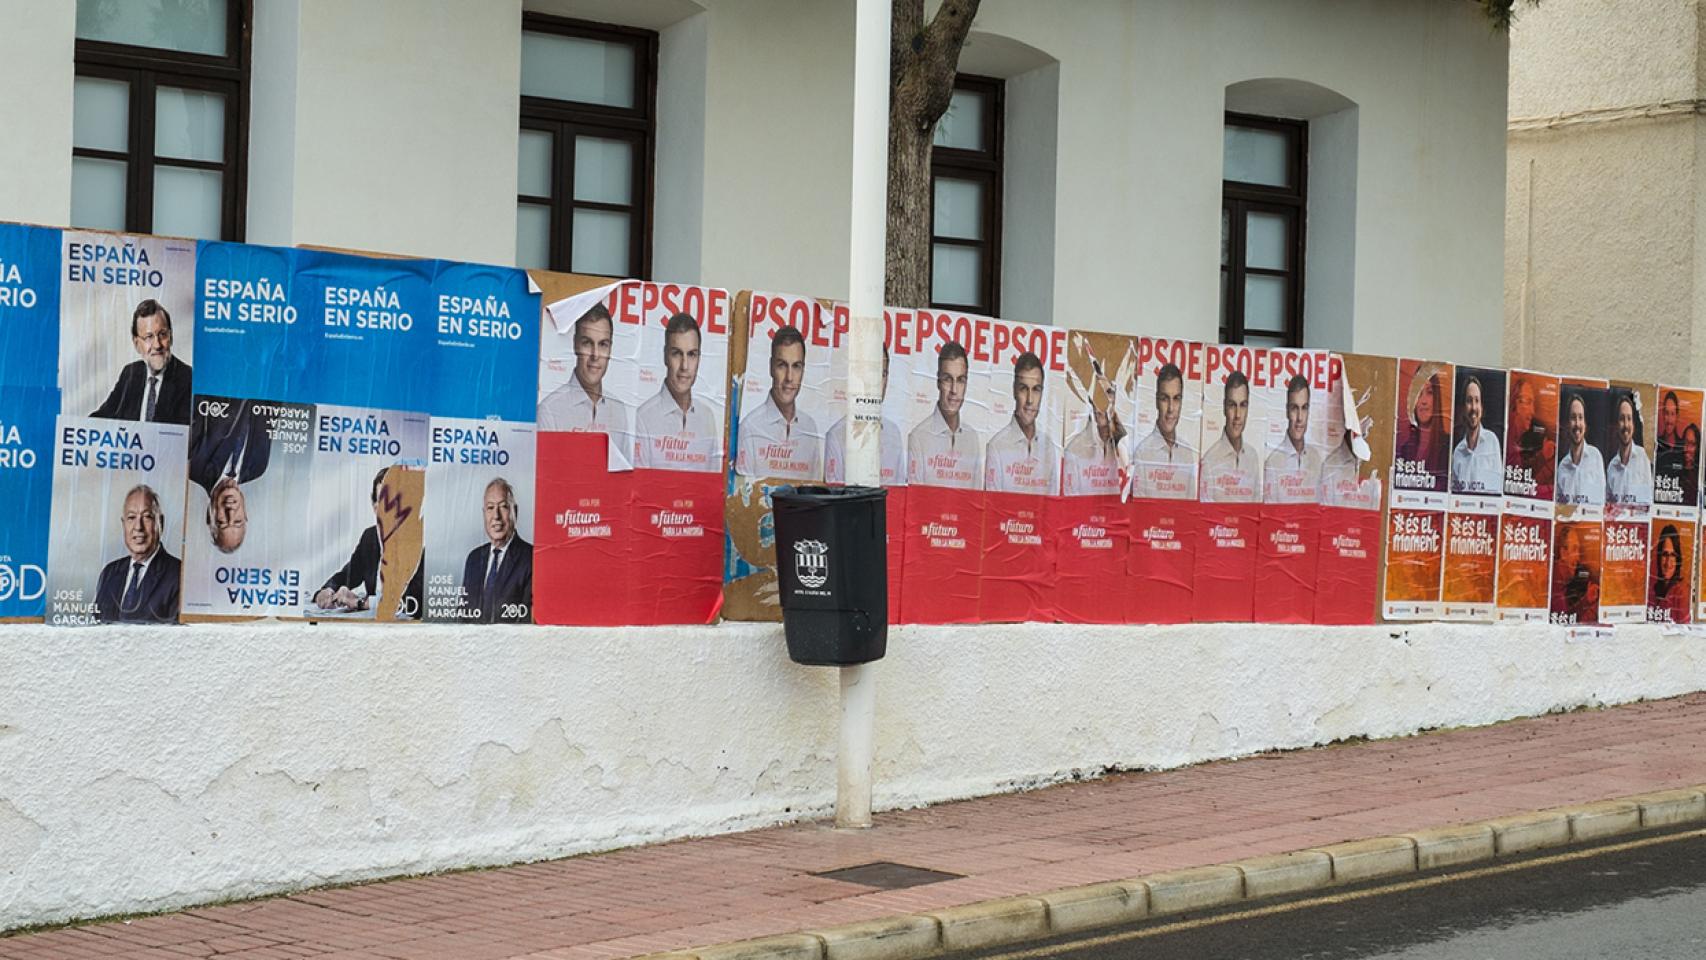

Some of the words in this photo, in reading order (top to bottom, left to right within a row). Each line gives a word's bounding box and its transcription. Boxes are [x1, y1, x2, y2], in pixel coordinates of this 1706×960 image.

[69, 243, 150, 266] ESPAÑA
[69, 265, 95, 283] EN
[103, 267, 164, 288] SERIO
[0, 288, 37, 308] RIO
[204, 278, 286, 301] ESPAÑA
[325, 286, 400, 309] ESPAÑA
[204, 301, 231, 320] EN
[239, 304, 297, 324] SERIO
[438, 295, 511, 319] ESPAÑA
[642, 281, 727, 334] PSOE
[324, 308, 350, 327] EN
[357, 311, 413, 331] SERIO
[438, 317, 462, 335] EN
[469, 320, 522, 340] SERIO
[915, 310, 990, 362] PSOE
[993, 324, 1066, 372] PSOE
[1138, 337, 1203, 380] PSOE
[1205, 346, 1267, 386] PSOE
[1269, 351, 1327, 388] PSOE
[252, 404, 310, 419] MARGALLO
[266, 429, 308, 442] MANUEL
[319, 414, 390, 437] ESPAÑA
[432, 426, 499, 447] ESPAÑA
[63, 427, 143, 450] ESPAÑA
[319, 434, 343, 452] EN
[348, 438, 400, 457] SERIO
[0, 450, 36, 468] RIO
[62, 449, 89, 467] EN
[96, 452, 155, 471] SERIO
[432, 446, 455, 462] EN
[460, 447, 510, 466] SERIO
[215, 567, 272, 585] SERIO
[279, 569, 300, 586] EN
[428, 574, 453, 585] JOSÉ
[53, 588, 84, 601] JOSÉ
[227, 587, 299, 609] ESPAÑA
[428, 586, 469, 596] MANUEL
[53, 602, 101, 614] MANUEL
[427, 608, 481, 619] MARGALLO
